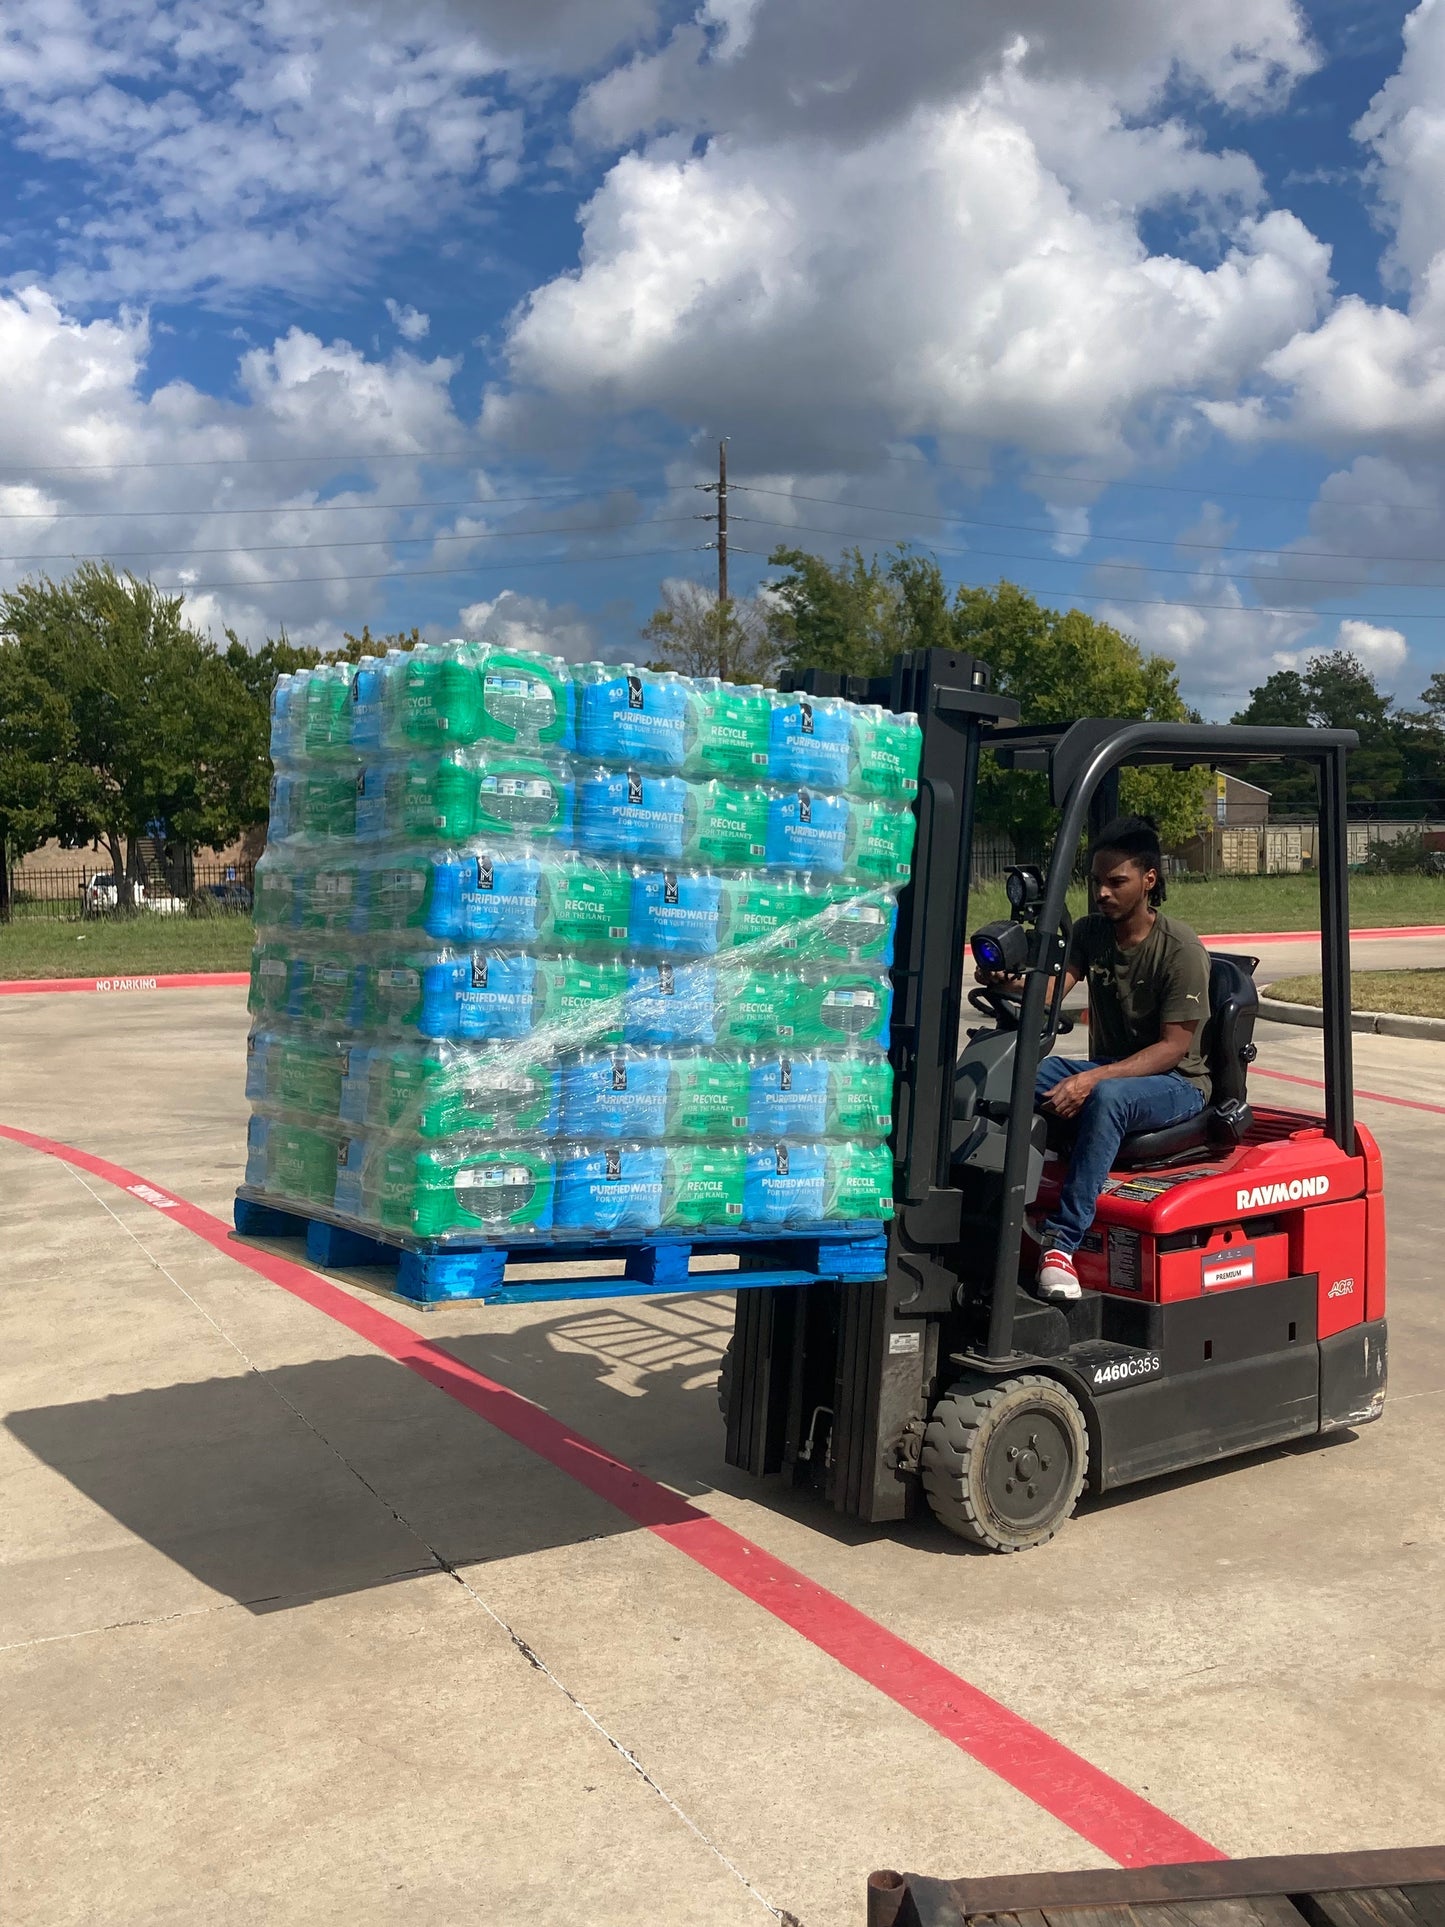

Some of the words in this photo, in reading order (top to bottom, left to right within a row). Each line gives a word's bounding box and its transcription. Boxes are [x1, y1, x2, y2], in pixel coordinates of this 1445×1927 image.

[608, 688, 623, 697] 40
[783, 713, 796, 723] 40
[652, 716, 685, 731] WATER
[711, 725, 747, 740] RECYCLE
[820, 741, 850, 753] WATER
[608, 784, 622, 792] 40
[781, 804, 794, 813] 40
[651, 811, 684, 824] WATER
[710, 817, 747, 831] RECYCLE
[645, 884, 659, 892] 40
[500, 896, 537, 907] WATER
[564, 899, 605, 913] RECYCLE
[687, 910, 719, 921] WATER
[452, 968, 466, 977] 40
[97, 980, 110, 991] NO
[113, 978, 156, 991] PARKING
[497, 993, 534, 1005] WATER
[762, 1073, 776, 1081] 40
[636, 1095, 667, 1105] WATER
[693, 1094, 728, 1104] RECYCLE
[586, 1163, 601, 1171] 40
[758, 1158, 771, 1167] 40
[687, 1181, 723, 1191] RECYCLE
[796, 1178, 825, 1187] WATER
[631, 1183, 662, 1193] WATER
[1236, 1176, 1329, 1210] RAYMOND
[705, 1190, 729, 1199] PLANET
[1215, 1269, 1242, 1281] PREMIUM
[1094, 1357, 1160, 1384] 4460C35S
